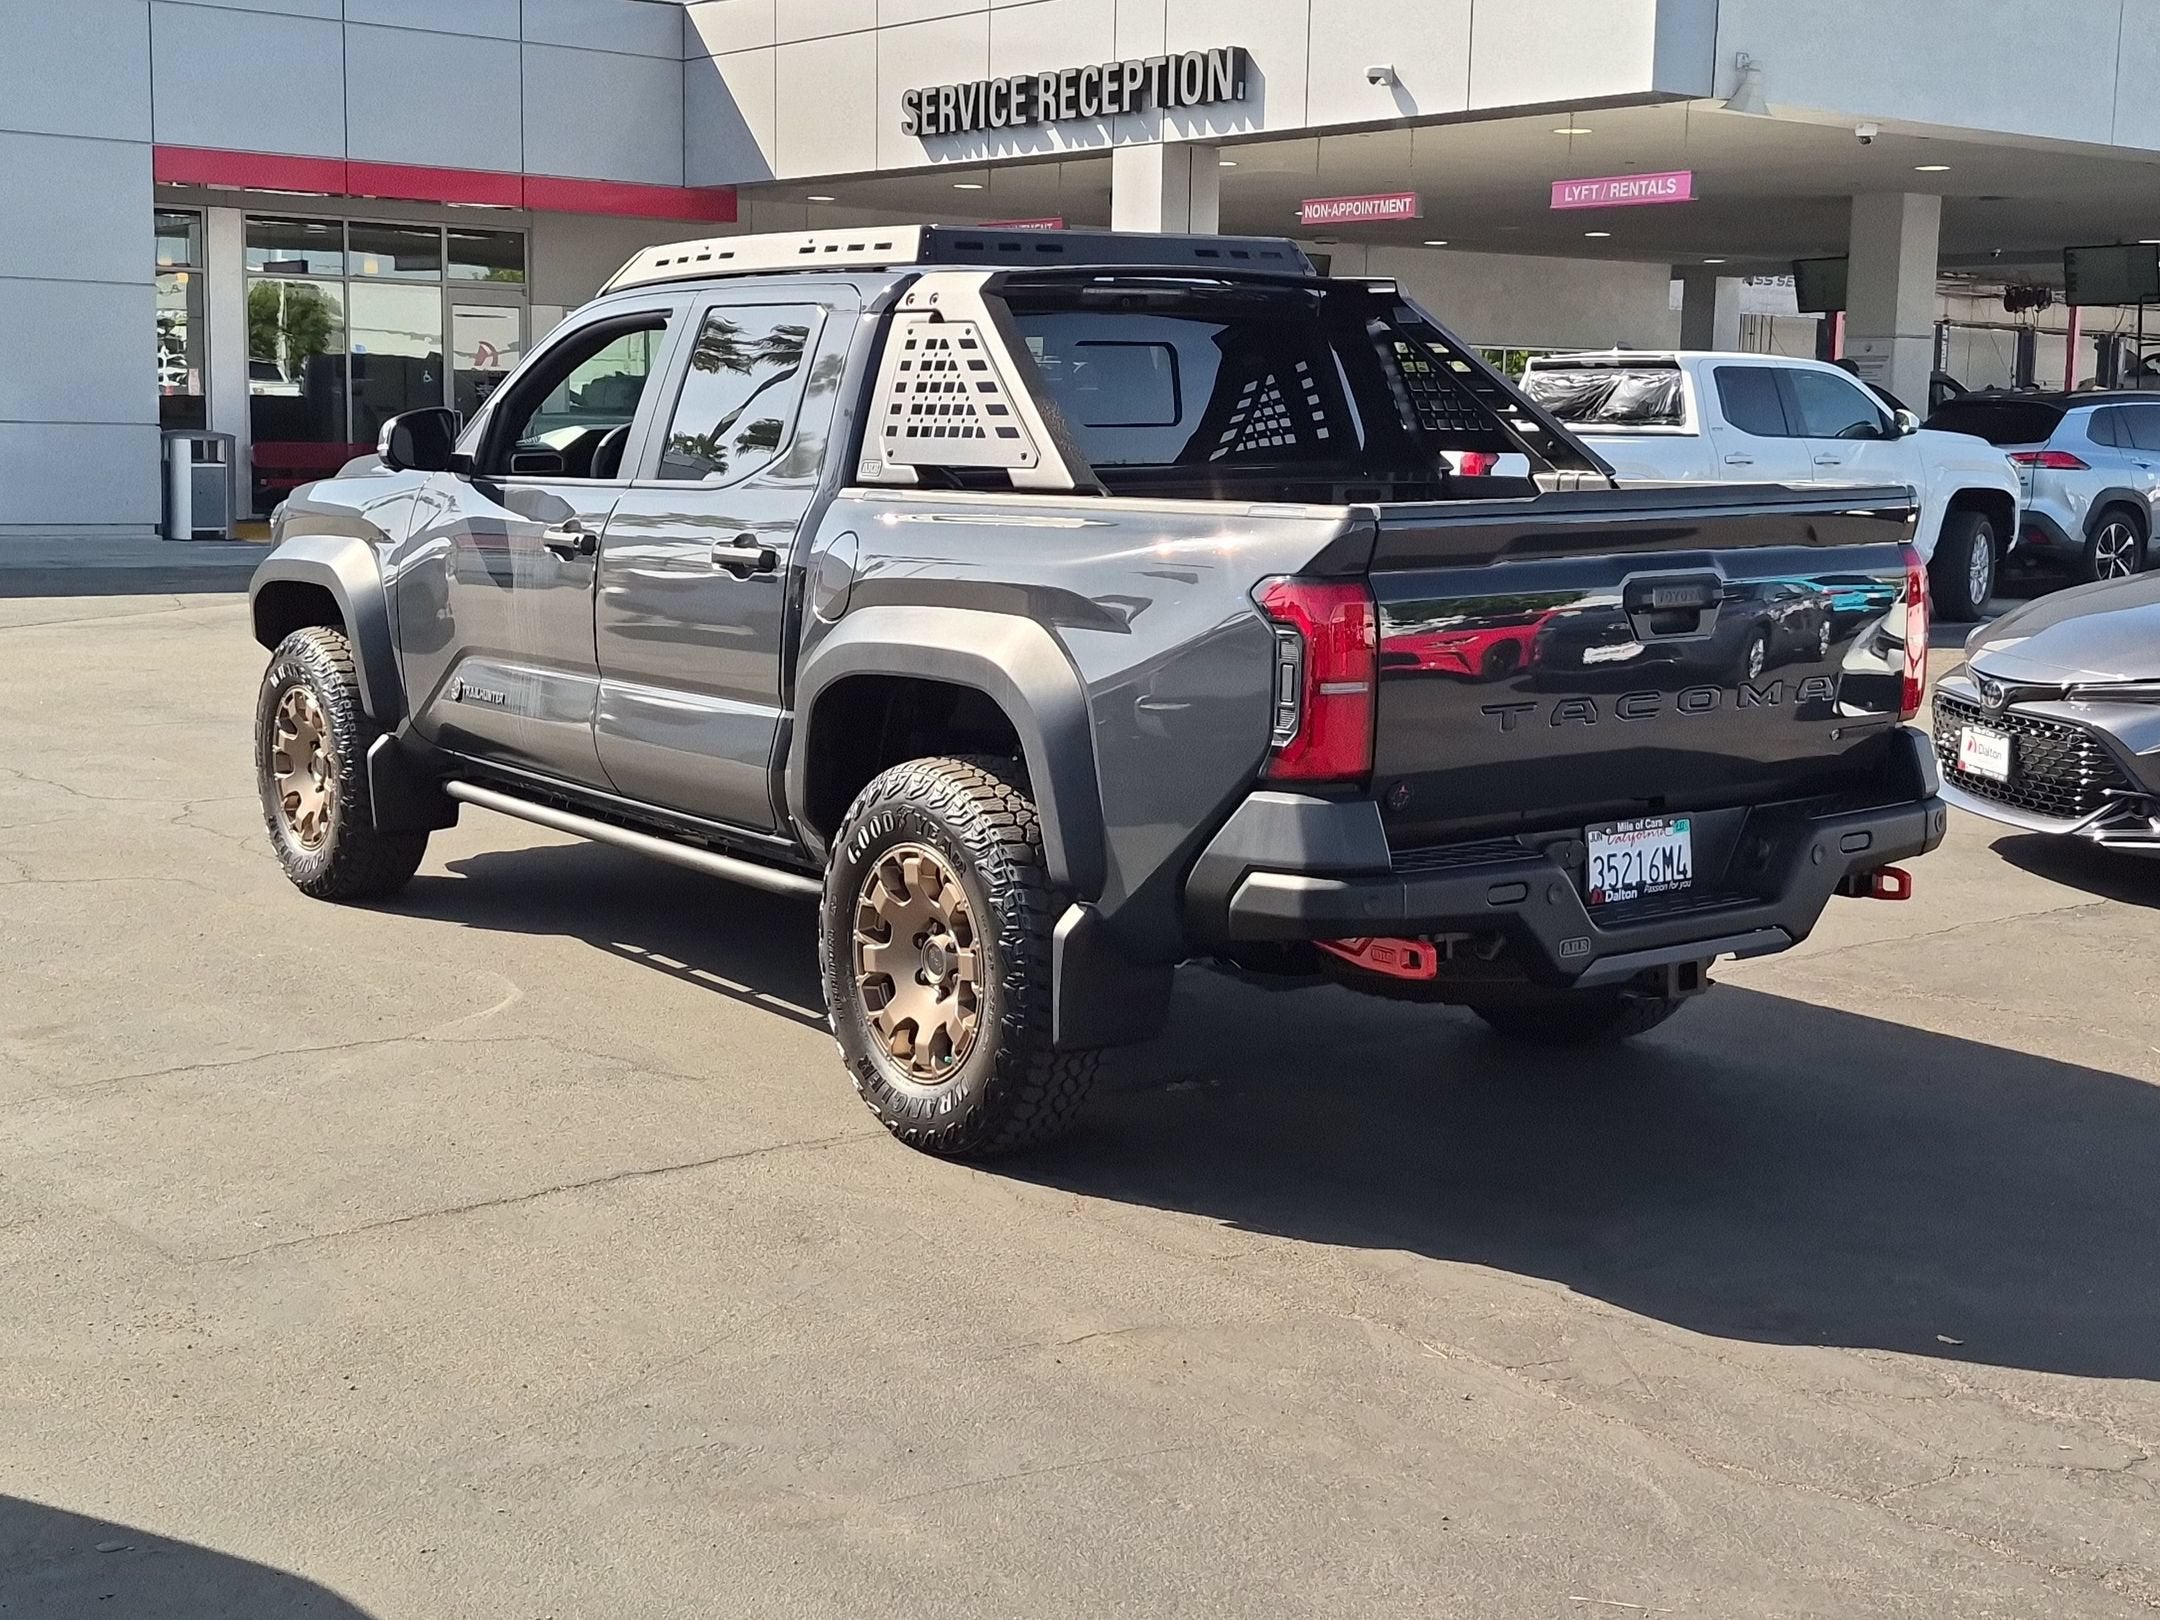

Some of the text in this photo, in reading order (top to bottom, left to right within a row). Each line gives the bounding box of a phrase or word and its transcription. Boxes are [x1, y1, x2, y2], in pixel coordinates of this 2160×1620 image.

[901, 75, 1027, 136] SERVICE
[1564, 184, 1599, 202] LYFT
[1609, 178, 1677, 198] RENTALS
[1304, 197, 1412, 218] NON-APPOINTMENT
[1481, 676, 1835, 733] TACOMA
[1978, 743, 2002, 760] Dalton
[1617, 821, 1633, 833] Mile
[1635, 820, 1643, 830] of
[1644, 818, 1663, 829] Cars
[1593, 844, 1689, 890] 35216M4
[1605, 888, 1638, 902] Dalton
[1643, 879, 1692, 894] Passion for you
[857, 1054, 971, 1120] WRANGLER
